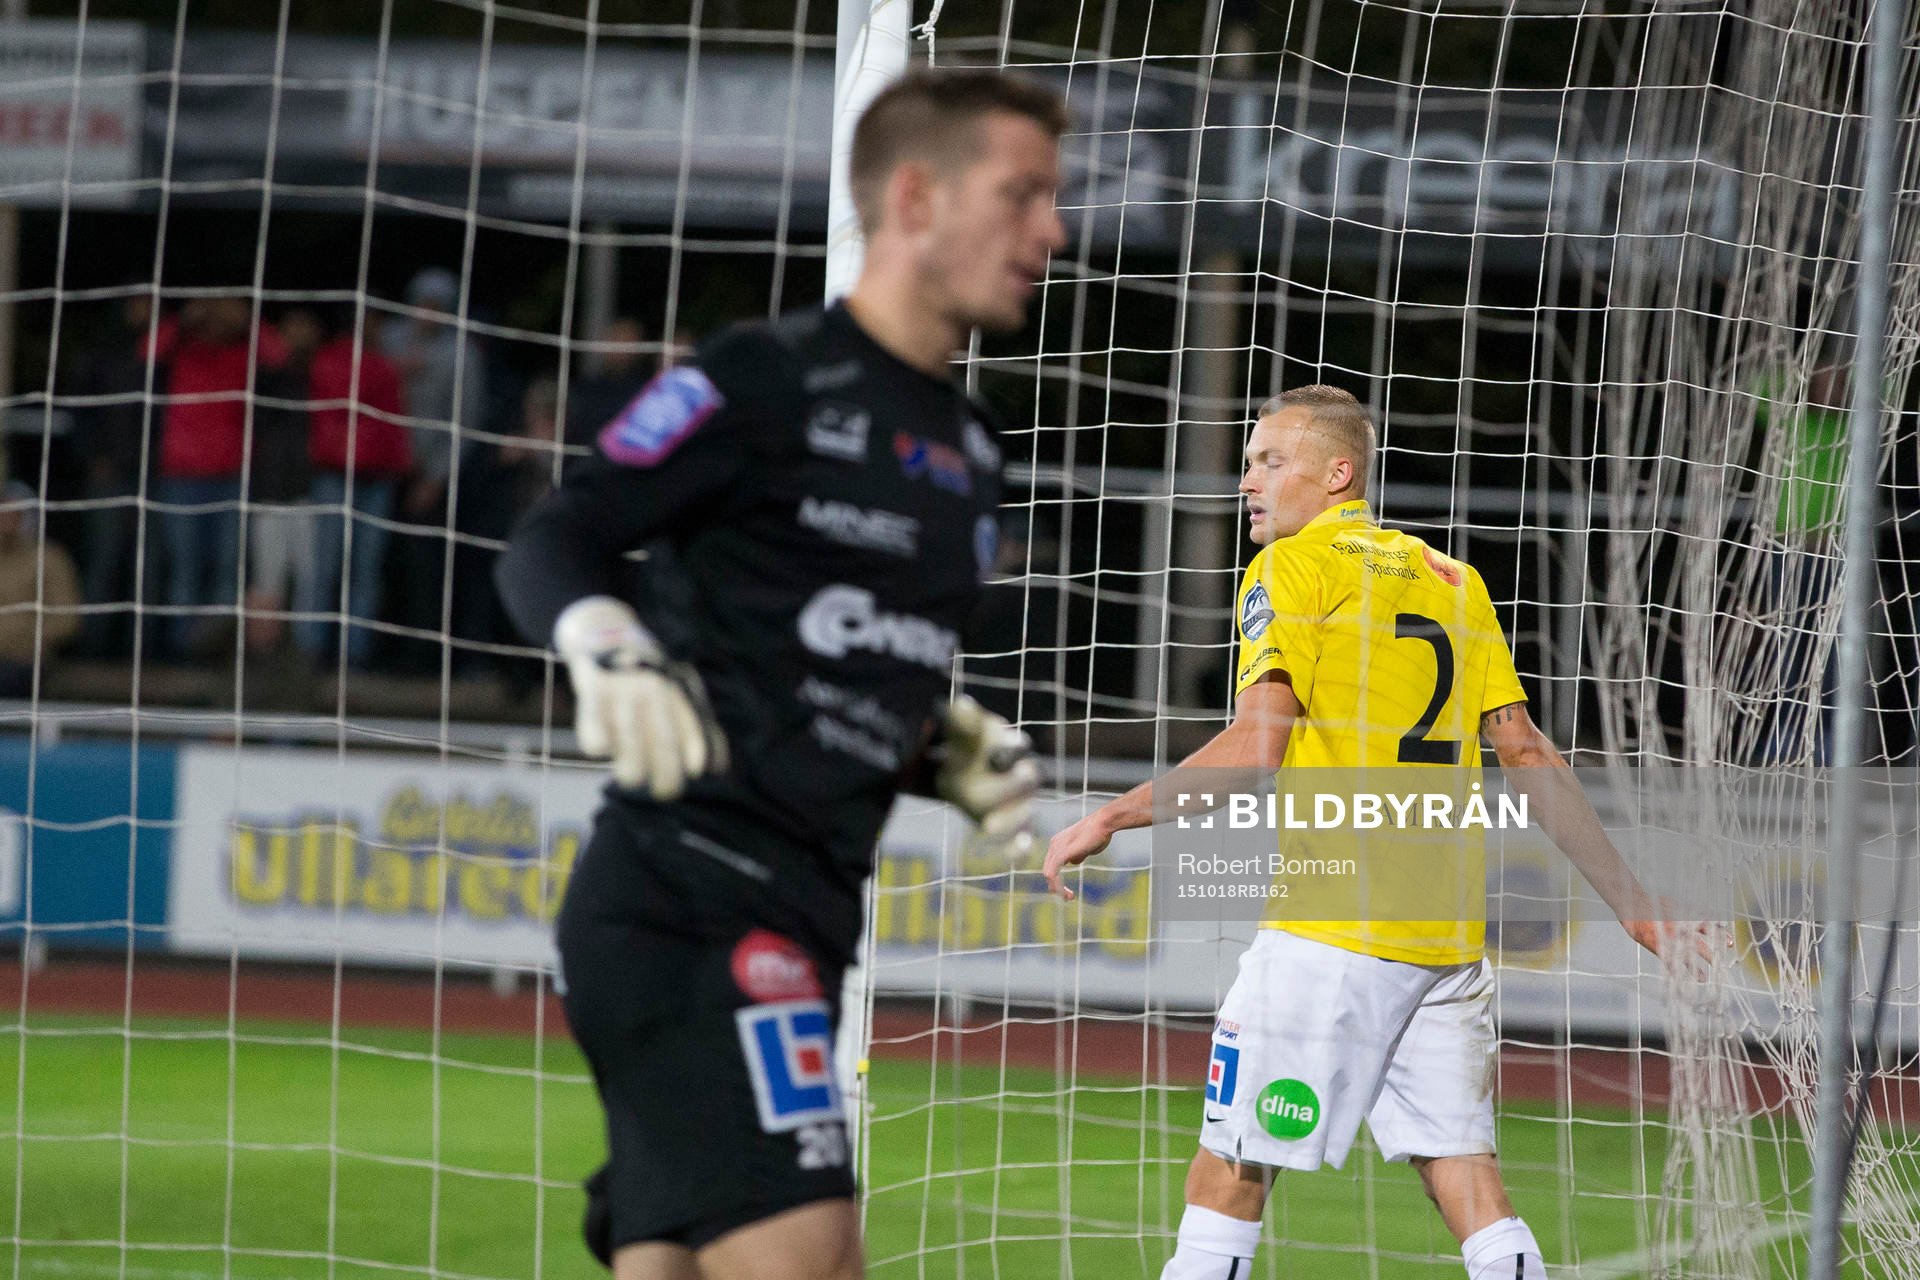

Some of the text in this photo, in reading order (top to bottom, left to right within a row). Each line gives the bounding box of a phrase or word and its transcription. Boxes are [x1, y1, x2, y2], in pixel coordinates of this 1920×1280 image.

[1363, 559, 1420, 580] Sparbank
[1395, 613, 1462, 765] 2
[1261, 1095, 1314, 1122] dina
